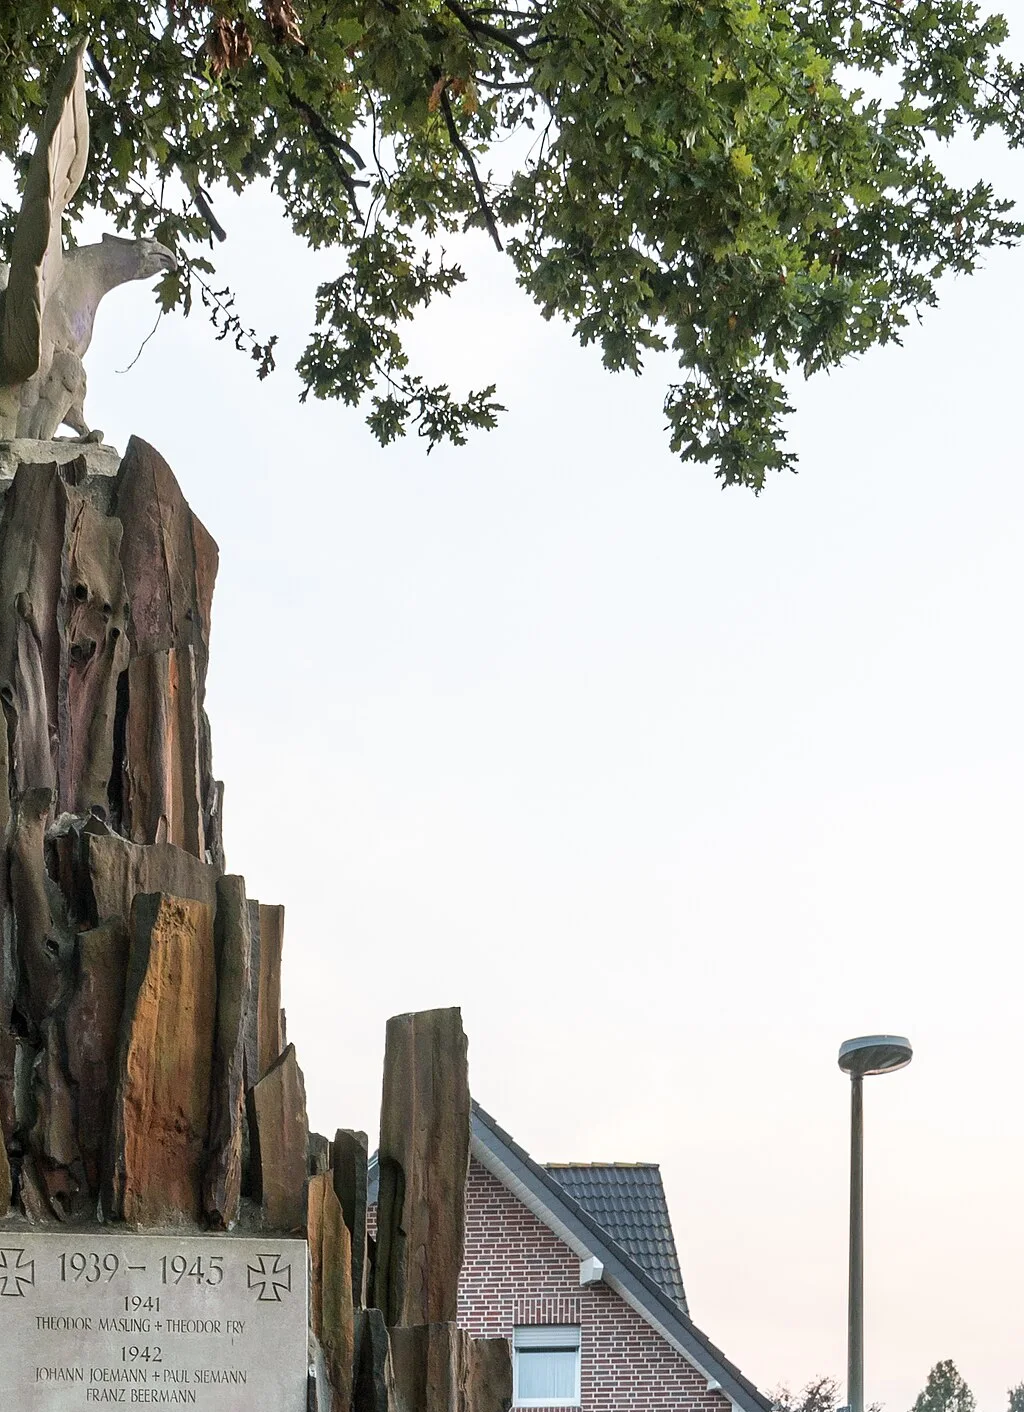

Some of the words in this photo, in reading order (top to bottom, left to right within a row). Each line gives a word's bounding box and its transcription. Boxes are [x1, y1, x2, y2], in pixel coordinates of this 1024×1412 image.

[58, 1252, 119, 1283] 1939
[159, 1255, 224, 1286] 1945
[125, 1296, 160, 1312] 1941
[36, 1317, 91, 1330] THEODOR
[98, 1318, 150, 1332] MASLING
[166, 1320, 221, 1333] THEODOR
[226, 1320, 246, 1334] FRY
[121, 1346, 162, 1362] 1942
[35, 1368, 83, 1382] JOHANN
[89, 1368, 146, 1383] JOEMANN
[163, 1369, 190, 1383] PAUL
[194, 1370, 247, 1384] SIEMANN
[86, 1389, 125, 1402] FRANZ
[131, 1389, 196, 1403] BEERMANN
